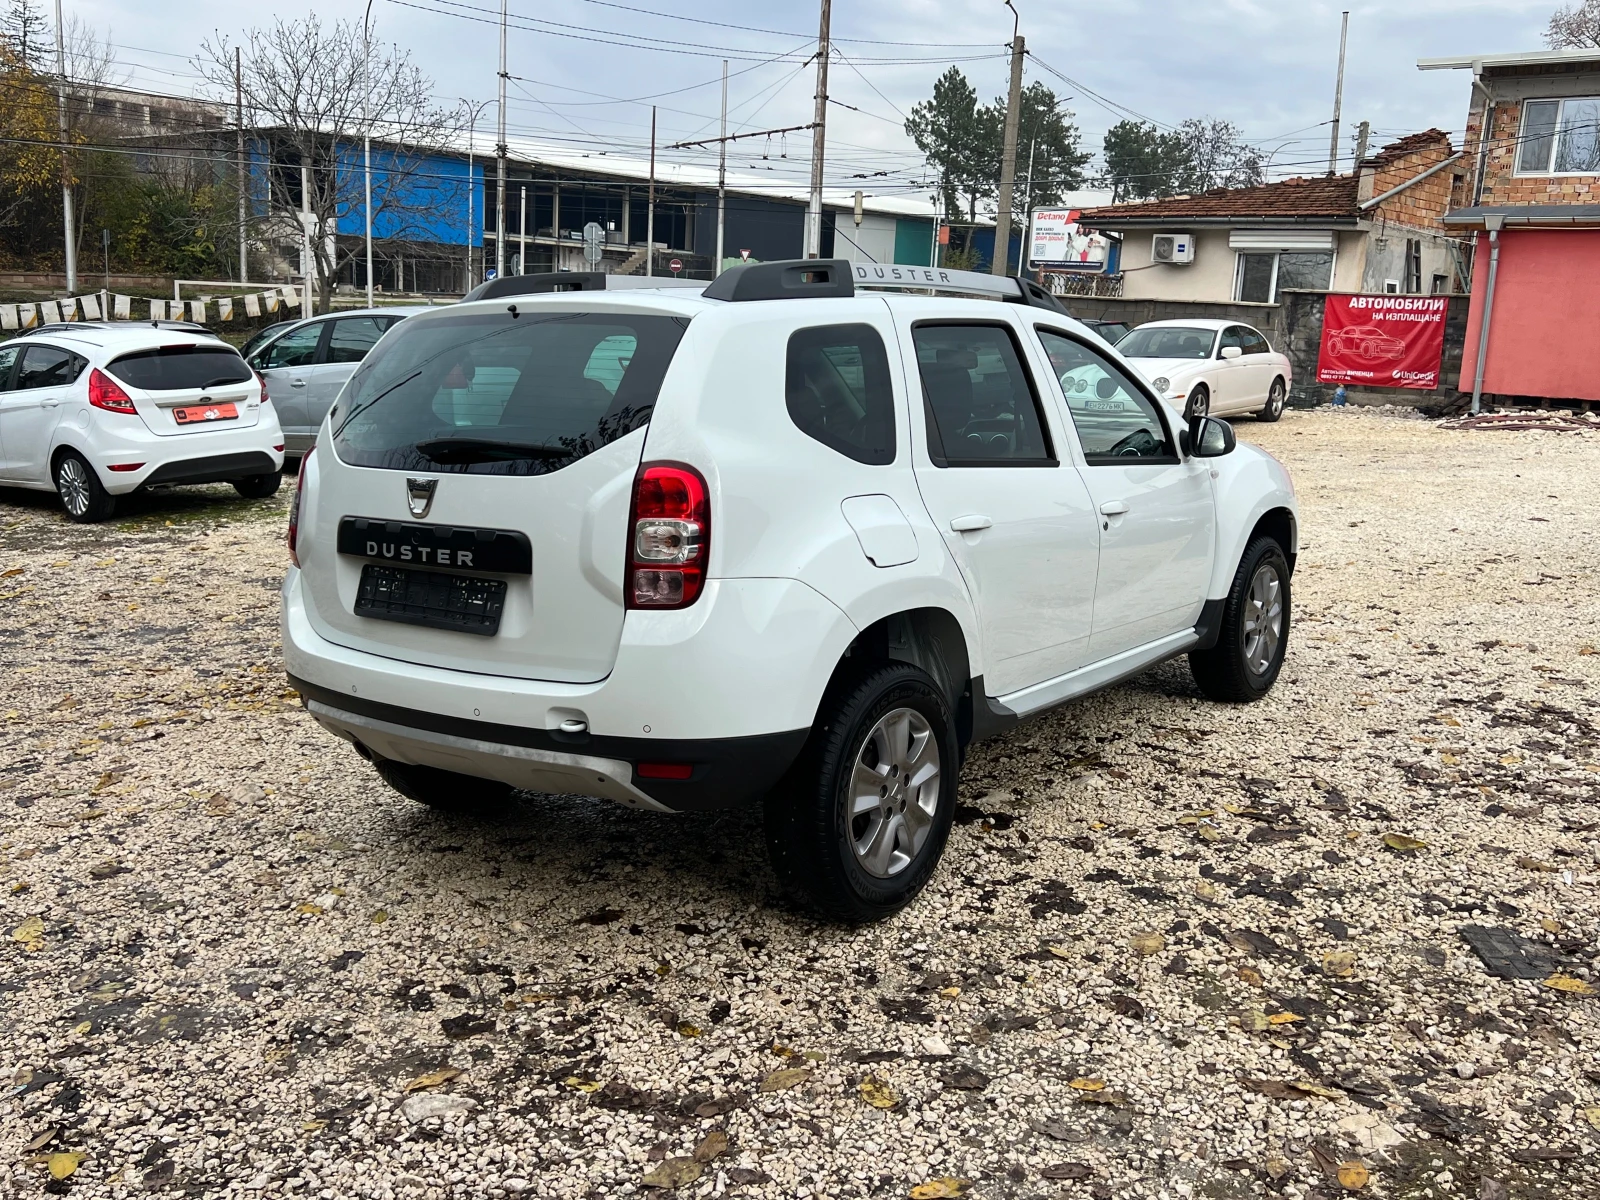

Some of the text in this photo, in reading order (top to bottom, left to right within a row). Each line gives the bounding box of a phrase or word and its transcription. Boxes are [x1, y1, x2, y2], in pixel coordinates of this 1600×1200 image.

[1037, 212, 1066, 220] Betano
[856, 266, 950, 283] DUSTER
[1348, 297, 1444, 311] АВТОМОБИЛИ
[1372, 312, 1441, 323] НА ИЗПЛАЩАНЕ
[1346, 370, 1374, 378] ВИЧЕНЦА
[1401, 370, 1435, 380] UniCredit
[366, 541, 474, 567] DUSTER
